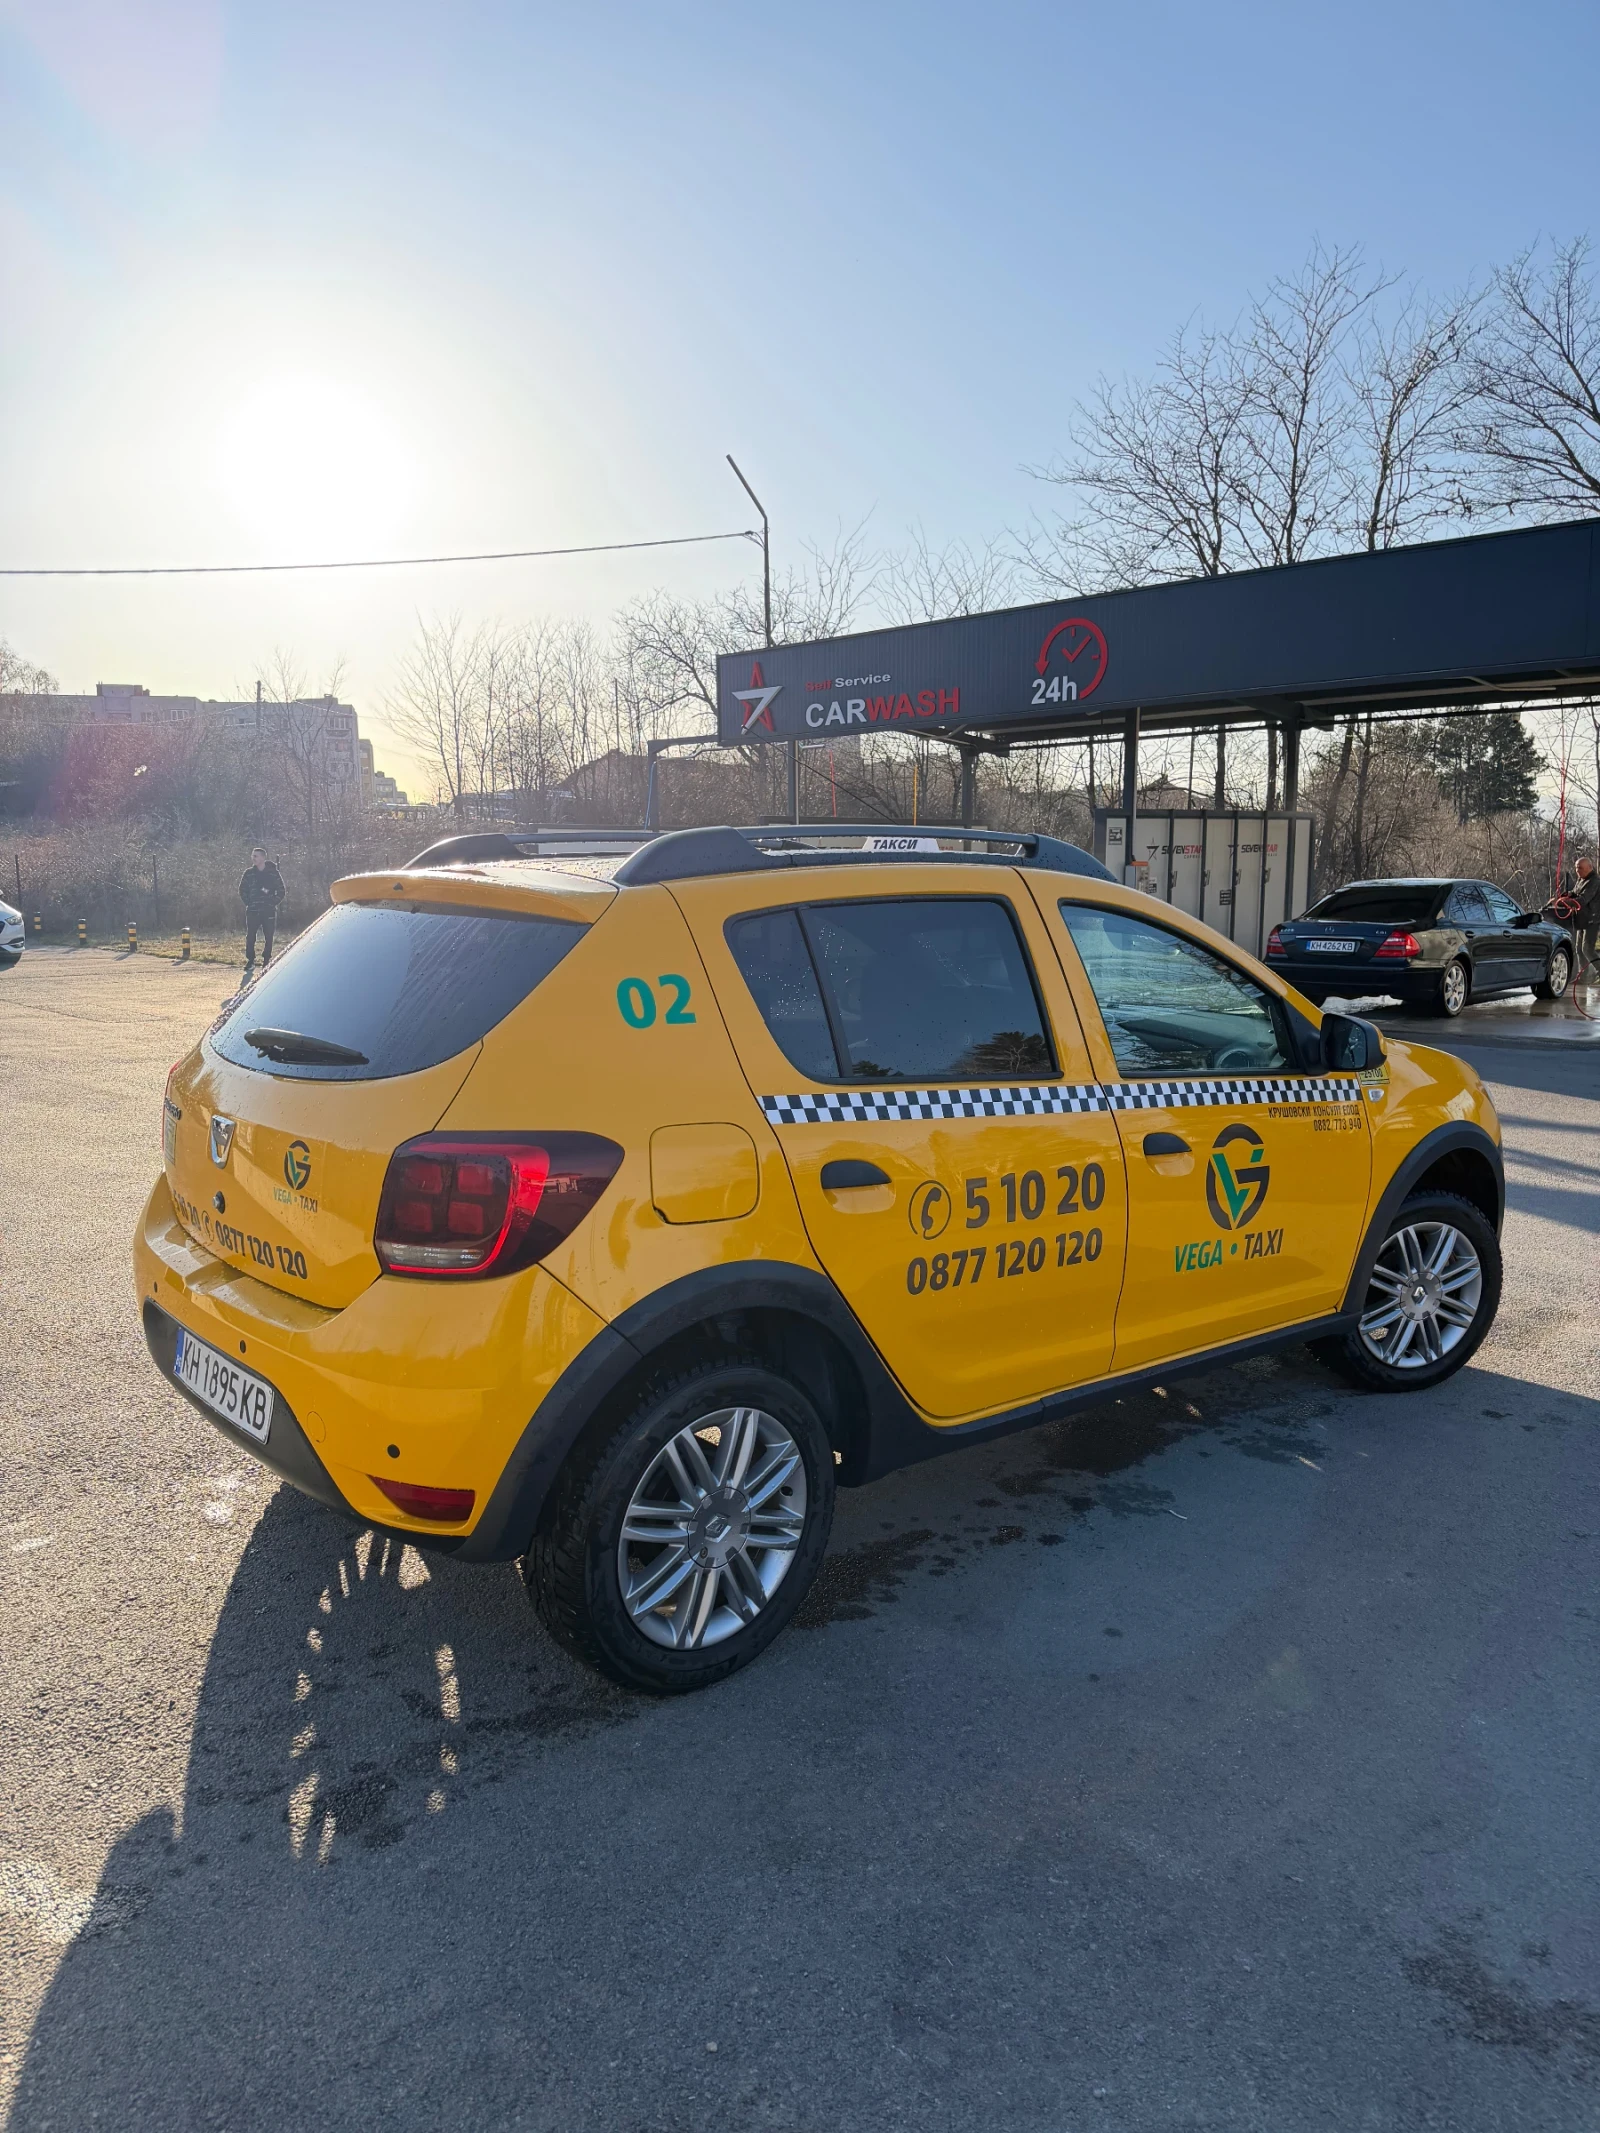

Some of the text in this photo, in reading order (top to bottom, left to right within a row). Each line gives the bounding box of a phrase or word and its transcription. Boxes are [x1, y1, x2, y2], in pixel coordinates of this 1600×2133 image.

[805, 673, 892, 692] Self Service
[1031, 675, 1077, 705] 24h
[873, 839, 918, 850] ТАКСИ
[616, 974, 697, 1029] 02
[1268, 1106, 1311, 1118] КРУШОВСКИ
[1343, 1104, 1360, 1116] ЕООД
[1314, 1118, 1361, 1131] 0882 773 940
[273, 1187, 318, 1213] VEGA TAXI
[966, 1162, 1105, 1229] 5 10 20
[187, 1201, 202, 1232] 20
[215, 1220, 246, 1257] 0877
[247, 1235, 275, 1269] 120
[276, 1246, 308, 1279] 120
[1175, 1228, 1284, 1272] VEGA TAXI
[907, 1227, 1103, 1296] 0877 120 120
